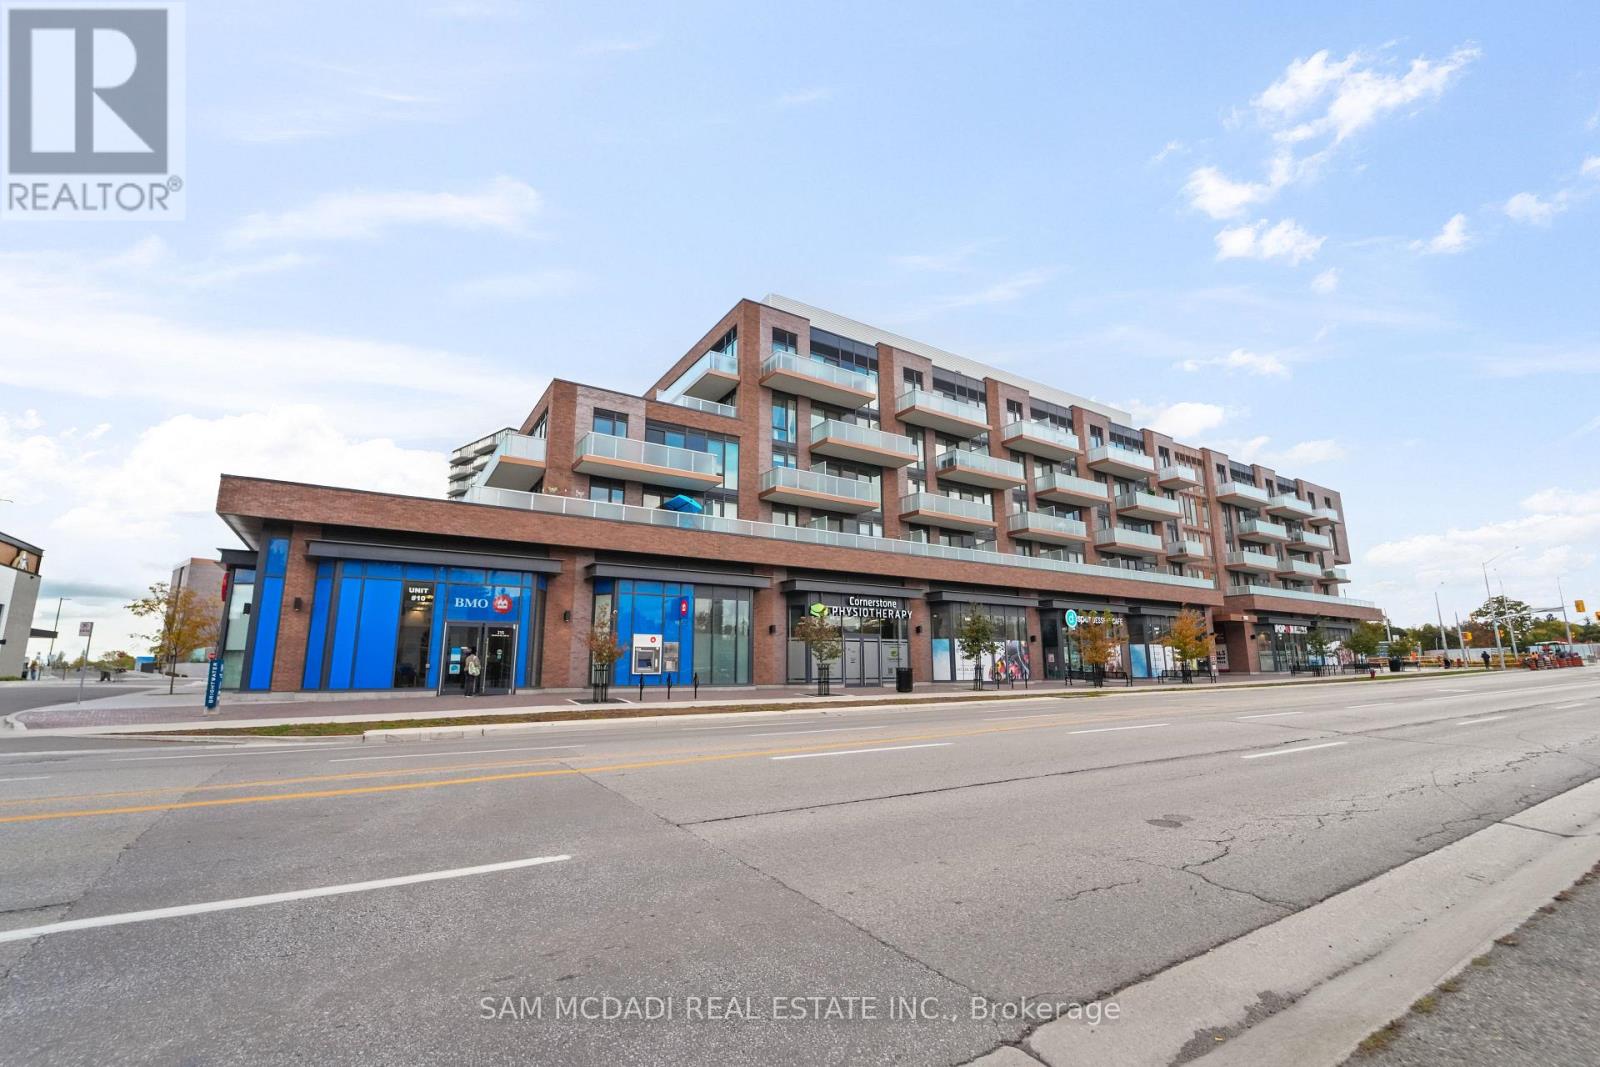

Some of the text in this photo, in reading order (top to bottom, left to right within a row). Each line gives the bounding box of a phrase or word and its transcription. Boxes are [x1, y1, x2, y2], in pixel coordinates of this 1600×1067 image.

[455, 597, 488, 608] BMO
[849, 596, 897, 608] Cornerstone
[832, 606, 913, 620] PHYSIOTHERAPY
[208, 662, 218, 704] BRIGHTWATER
